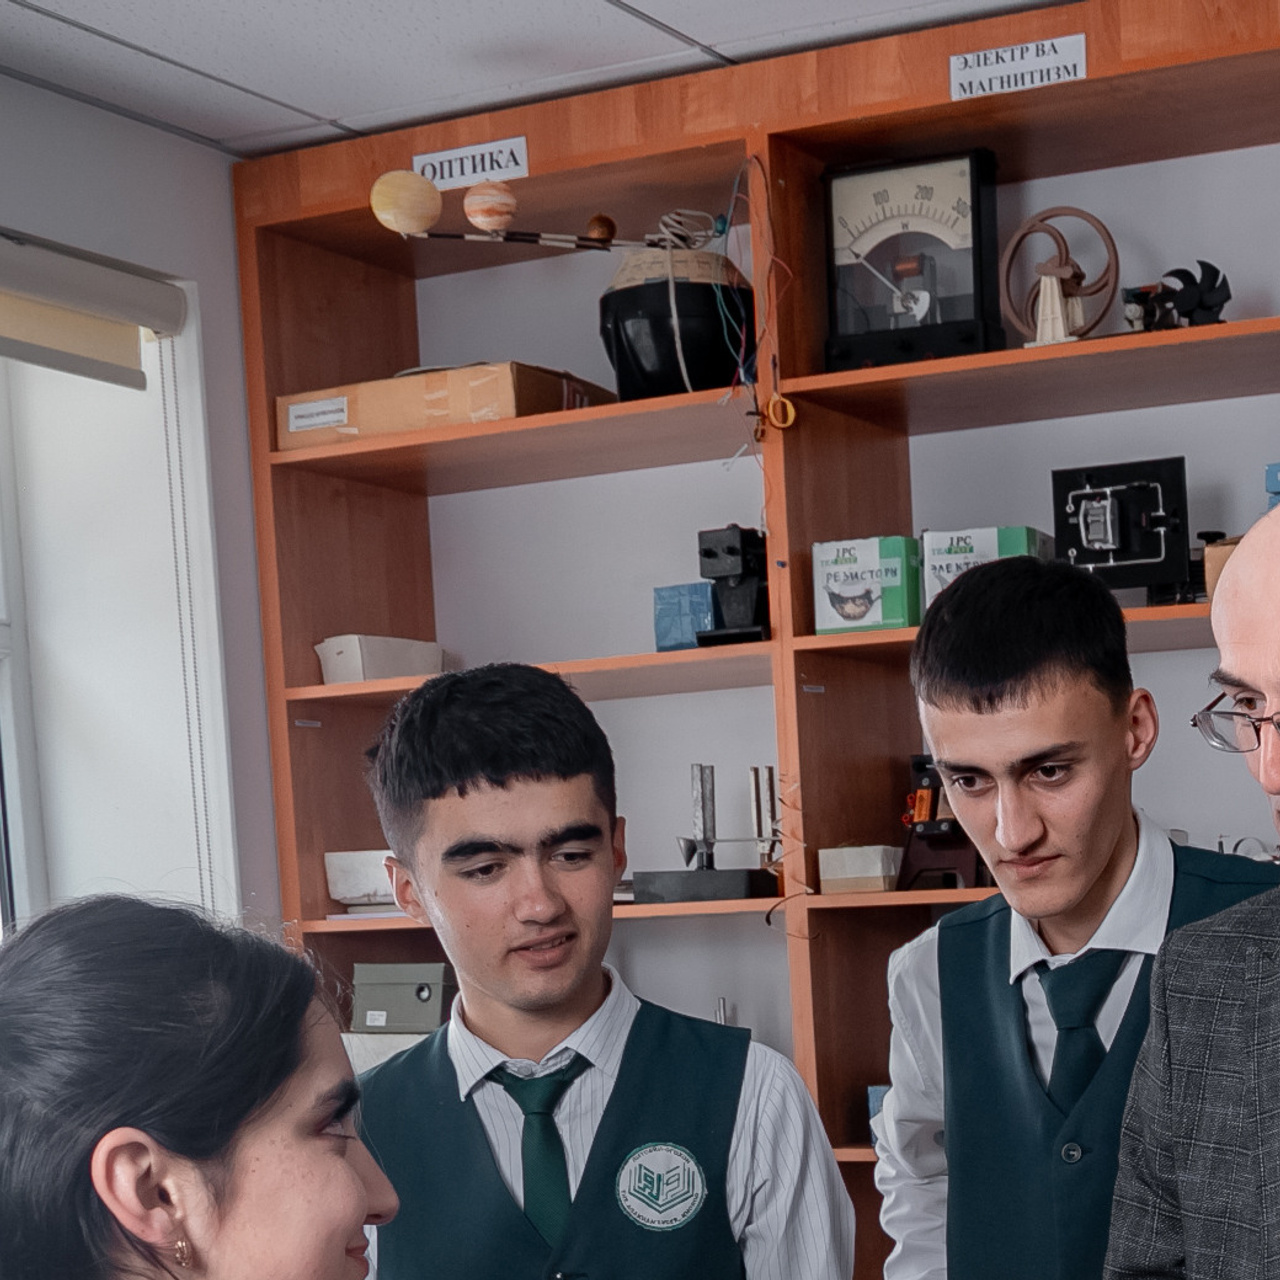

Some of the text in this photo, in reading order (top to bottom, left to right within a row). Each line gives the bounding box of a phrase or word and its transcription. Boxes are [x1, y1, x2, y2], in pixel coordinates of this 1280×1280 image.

[957, 42, 1058, 71] ЭЛЕКТР ВА
[958, 63, 1078, 97] МАГНИТИЗМ
[421, 148, 521, 181] ОПТИКА
[872, 189, 890, 206] 100
[914, 184, 934, 202] 200
